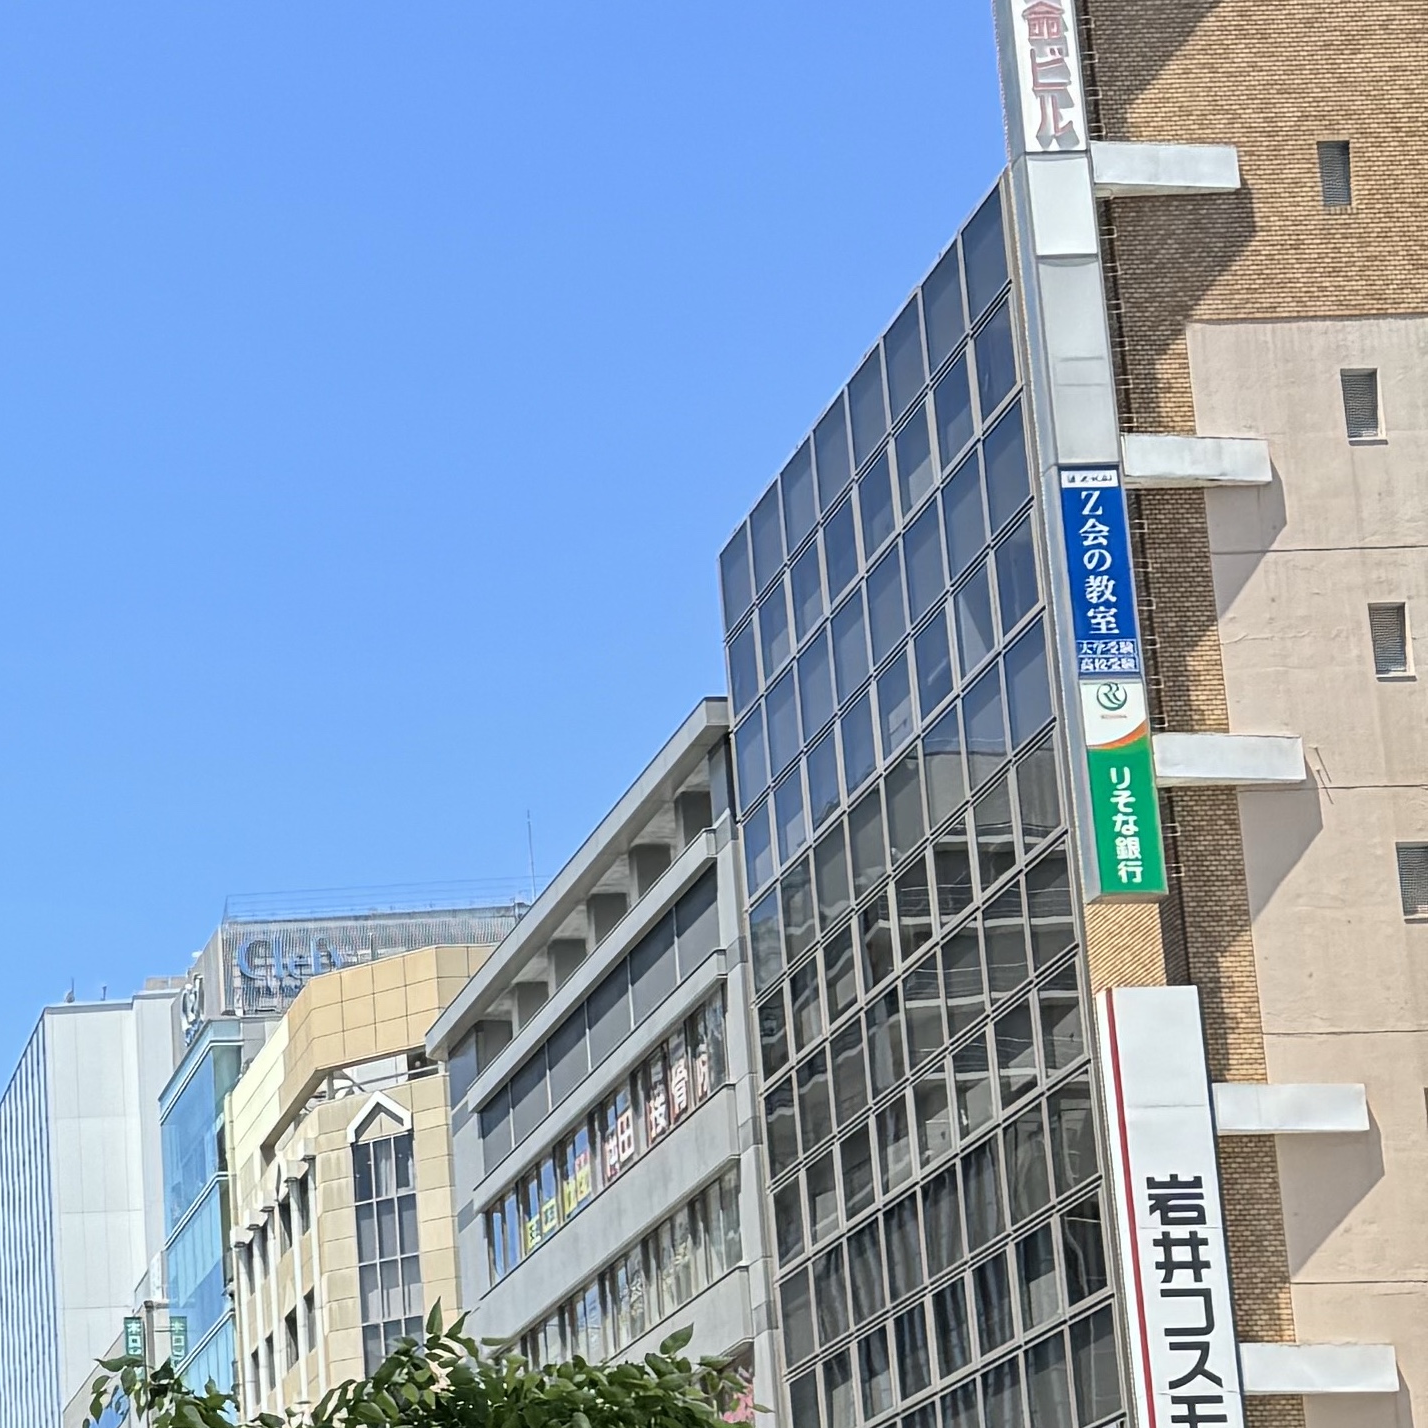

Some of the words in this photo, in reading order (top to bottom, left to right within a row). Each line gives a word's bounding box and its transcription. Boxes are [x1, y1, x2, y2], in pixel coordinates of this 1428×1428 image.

[1078, 491, 1120, 635] Z会の教室
[1109, 766, 1143, 884] りそな銀行
